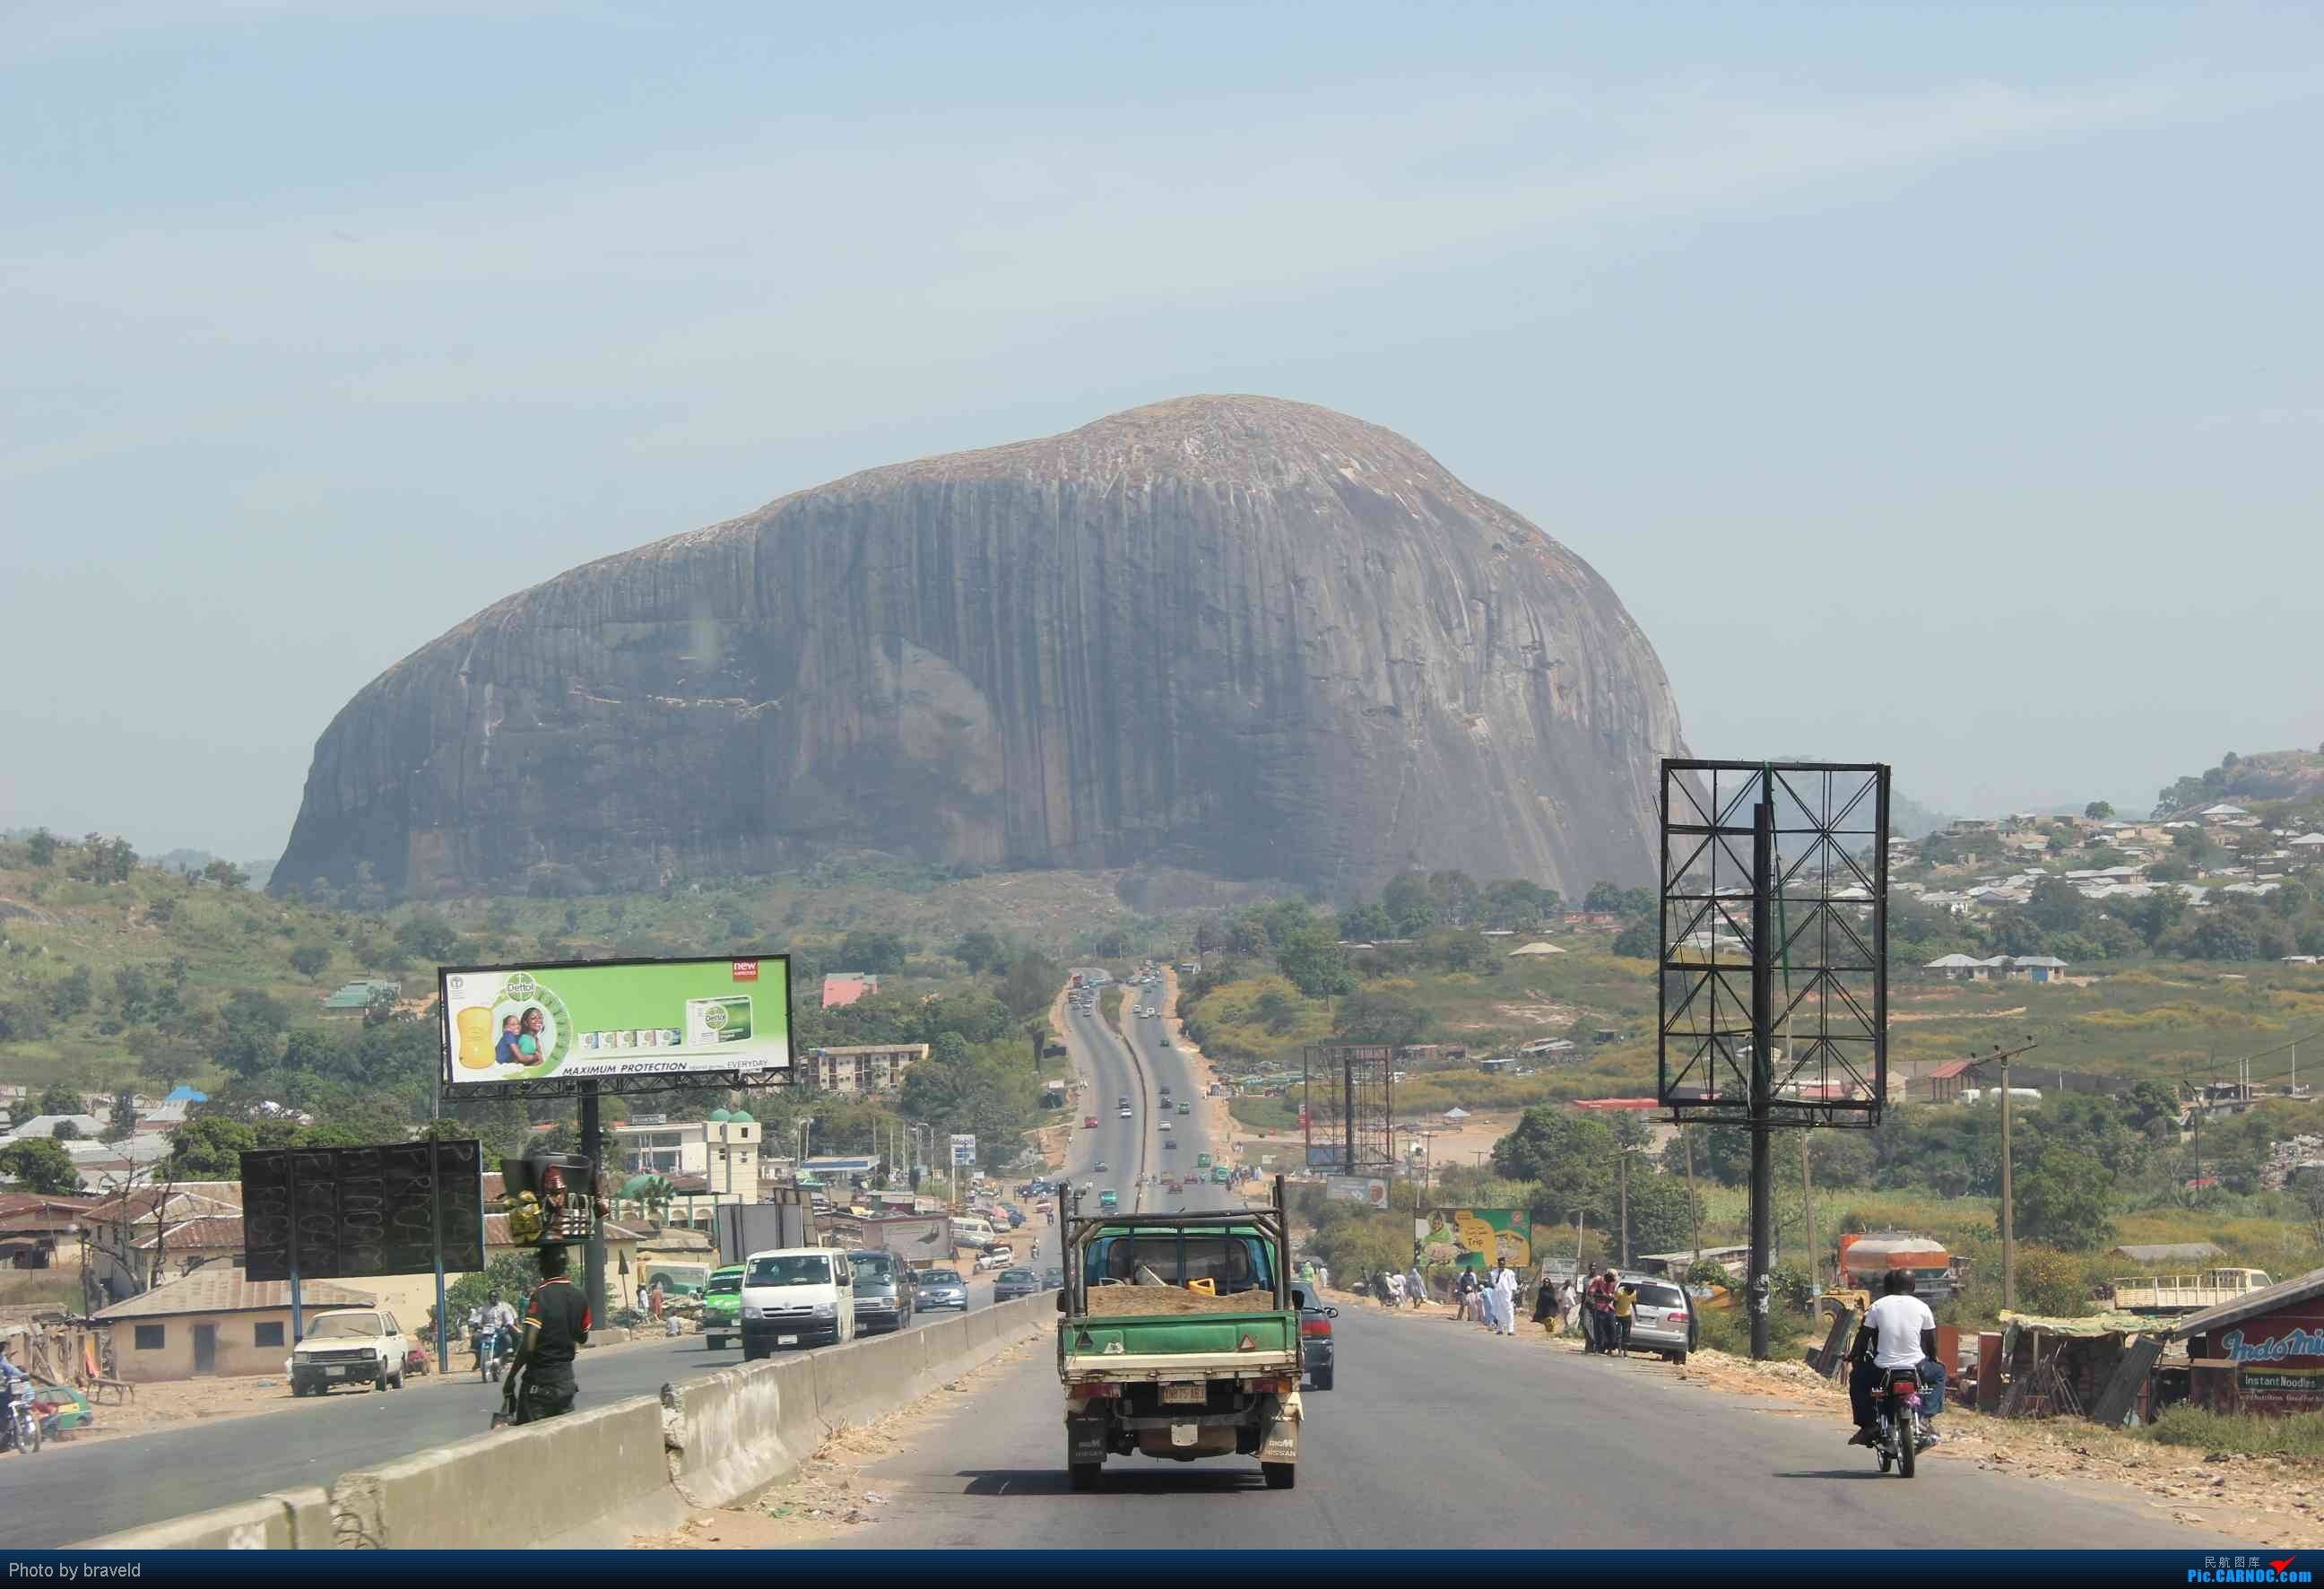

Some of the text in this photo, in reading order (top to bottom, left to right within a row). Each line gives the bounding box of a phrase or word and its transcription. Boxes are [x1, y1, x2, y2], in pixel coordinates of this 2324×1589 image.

[733, 962, 755, 970] new
[507, 982, 533, 992] Dettol
[562, 1064, 617, 1075] MAXIMUM
[620, 1062, 688, 1072] PROTECTION
[727, 1059, 768, 1069] EVERYDAY
[2245, 1374, 2317, 1388] Instant Noodles
